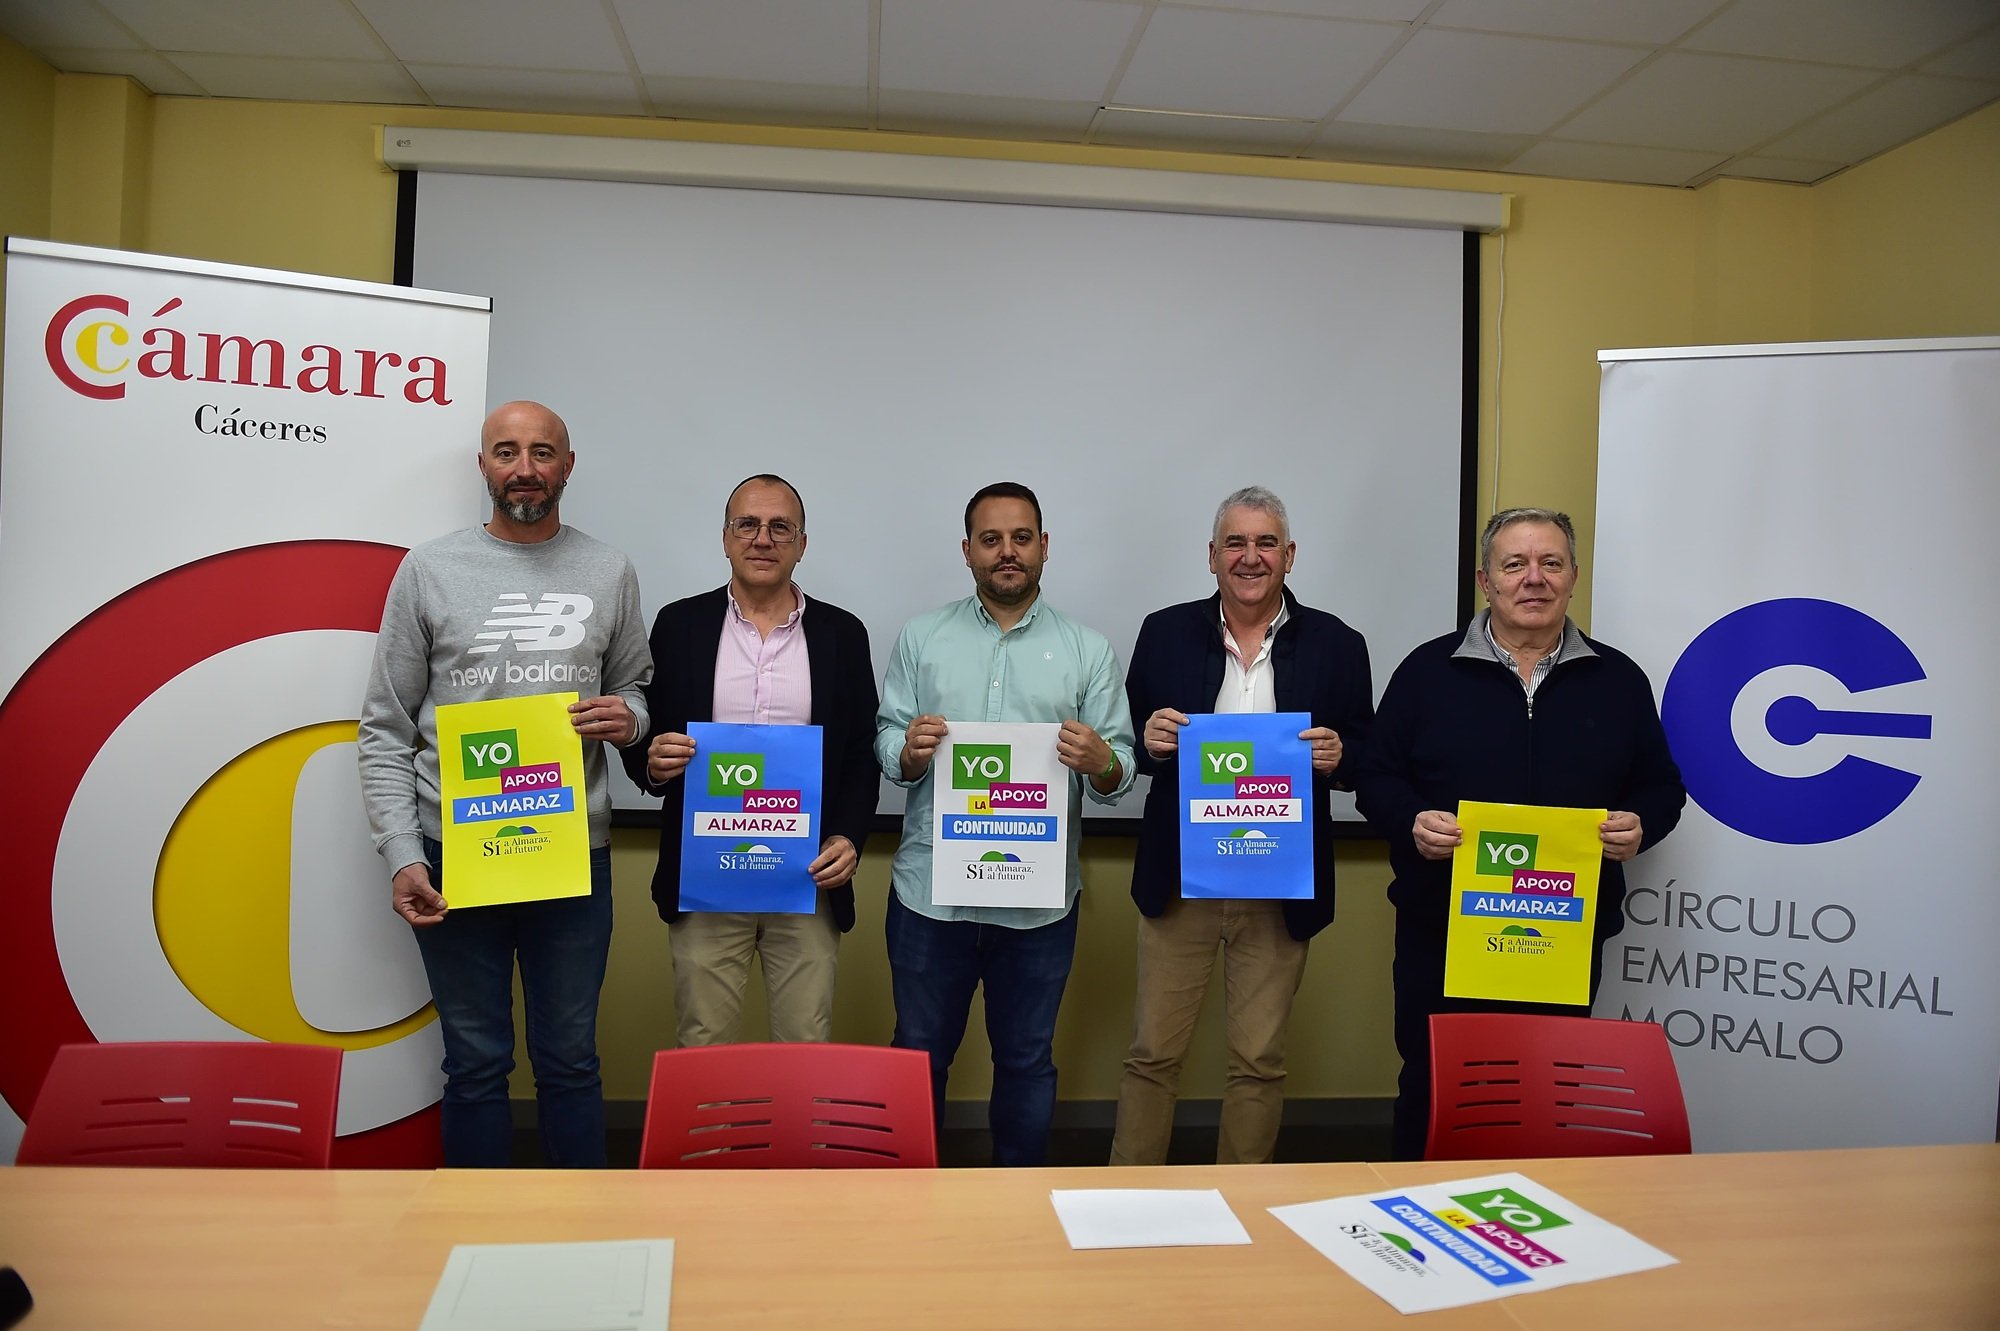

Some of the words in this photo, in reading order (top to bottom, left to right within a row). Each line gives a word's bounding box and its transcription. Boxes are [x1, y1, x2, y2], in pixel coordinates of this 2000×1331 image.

[194, 403, 328, 444] Cáceres
[450, 665, 498, 687] new
[505, 659, 598, 683] balance
[468, 742, 513, 767] YO
[1207, 752, 1248, 773] YO
[716, 764, 758, 786] YO
[960, 756, 1004, 779] YO
[504, 771, 559, 788] APOYO
[990, 790, 1046, 802] APOYO
[1238, 783, 1289, 795] APOYO
[466, 793, 561, 817] ALMARAZ
[745, 797, 798, 809] APOYO
[974, 800, 986, 810] LA
[1203, 804, 1289, 817] ALMARAZ
[707, 818, 797, 832] ALMARAZ
[953, 820, 1046, 836] CONTINUIDAD
[483, 840, 501, 857] Sí
[504, 846, 513, 855] al
[515, 844, 543, 854] futuro
[1217, 840, 1233, 855] Sí
[1236, 847, 1244, 855] al
[1245, 847, 1271, 855] futuro
[1485, 842, 1530, 866] YO
[719, 854, 737, 870] Sí
[739, 862, 747, 870] al
[749, 862, 776, 870] futuro
[966, 863, 984, 880] Sí
[987, 872, 995, 880] al
[998, 872, 1025, 880] futuro
[1515, 877, 1572, 892] APOYO
[1474, 897, 1570, 916] ALMARAZ
[1624, 879, 1856, 944] CÍRCULO
[1486, 936, 1504, 953] Sí
[1507, 945, 1516, 953] al
[1518, 946, 1545, 955] futuro
[1622, 945, 1954, 1017] EMPRESARIAL
[1446, 1213, 1467, 1224] LA
[1480, 1194, 1543, 1228] YO
[1390, 1204, 1509, 1277] CONTINUIDAD
[1475, 1221, 1553, 1266] APOYO
